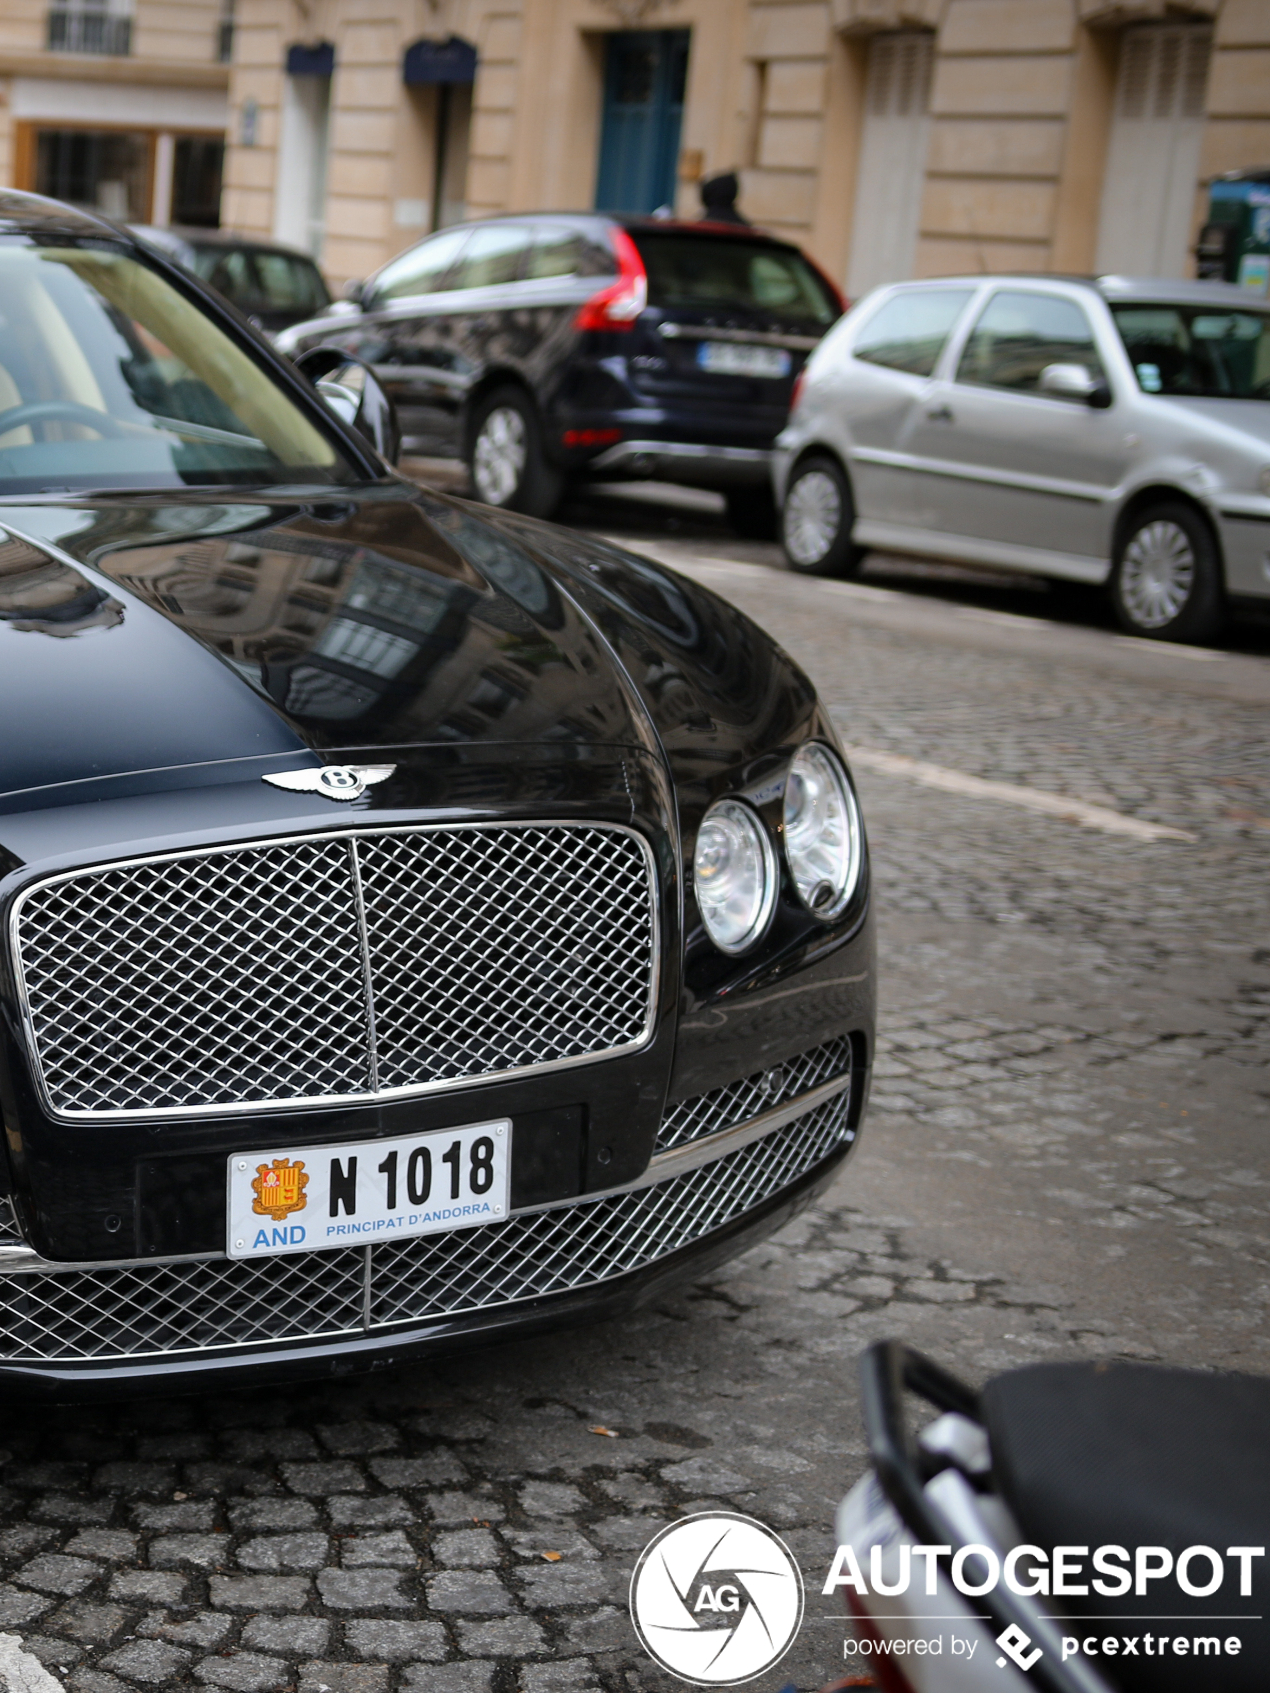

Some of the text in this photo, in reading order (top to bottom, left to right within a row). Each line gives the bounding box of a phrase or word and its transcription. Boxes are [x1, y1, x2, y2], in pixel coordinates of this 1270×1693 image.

[330, 1136, 494, 1217] N 1018
[327, 1202, 491, 1236] PRINCIPAT D'ANDORRA
[253, 1225, 306, 1248] AND
